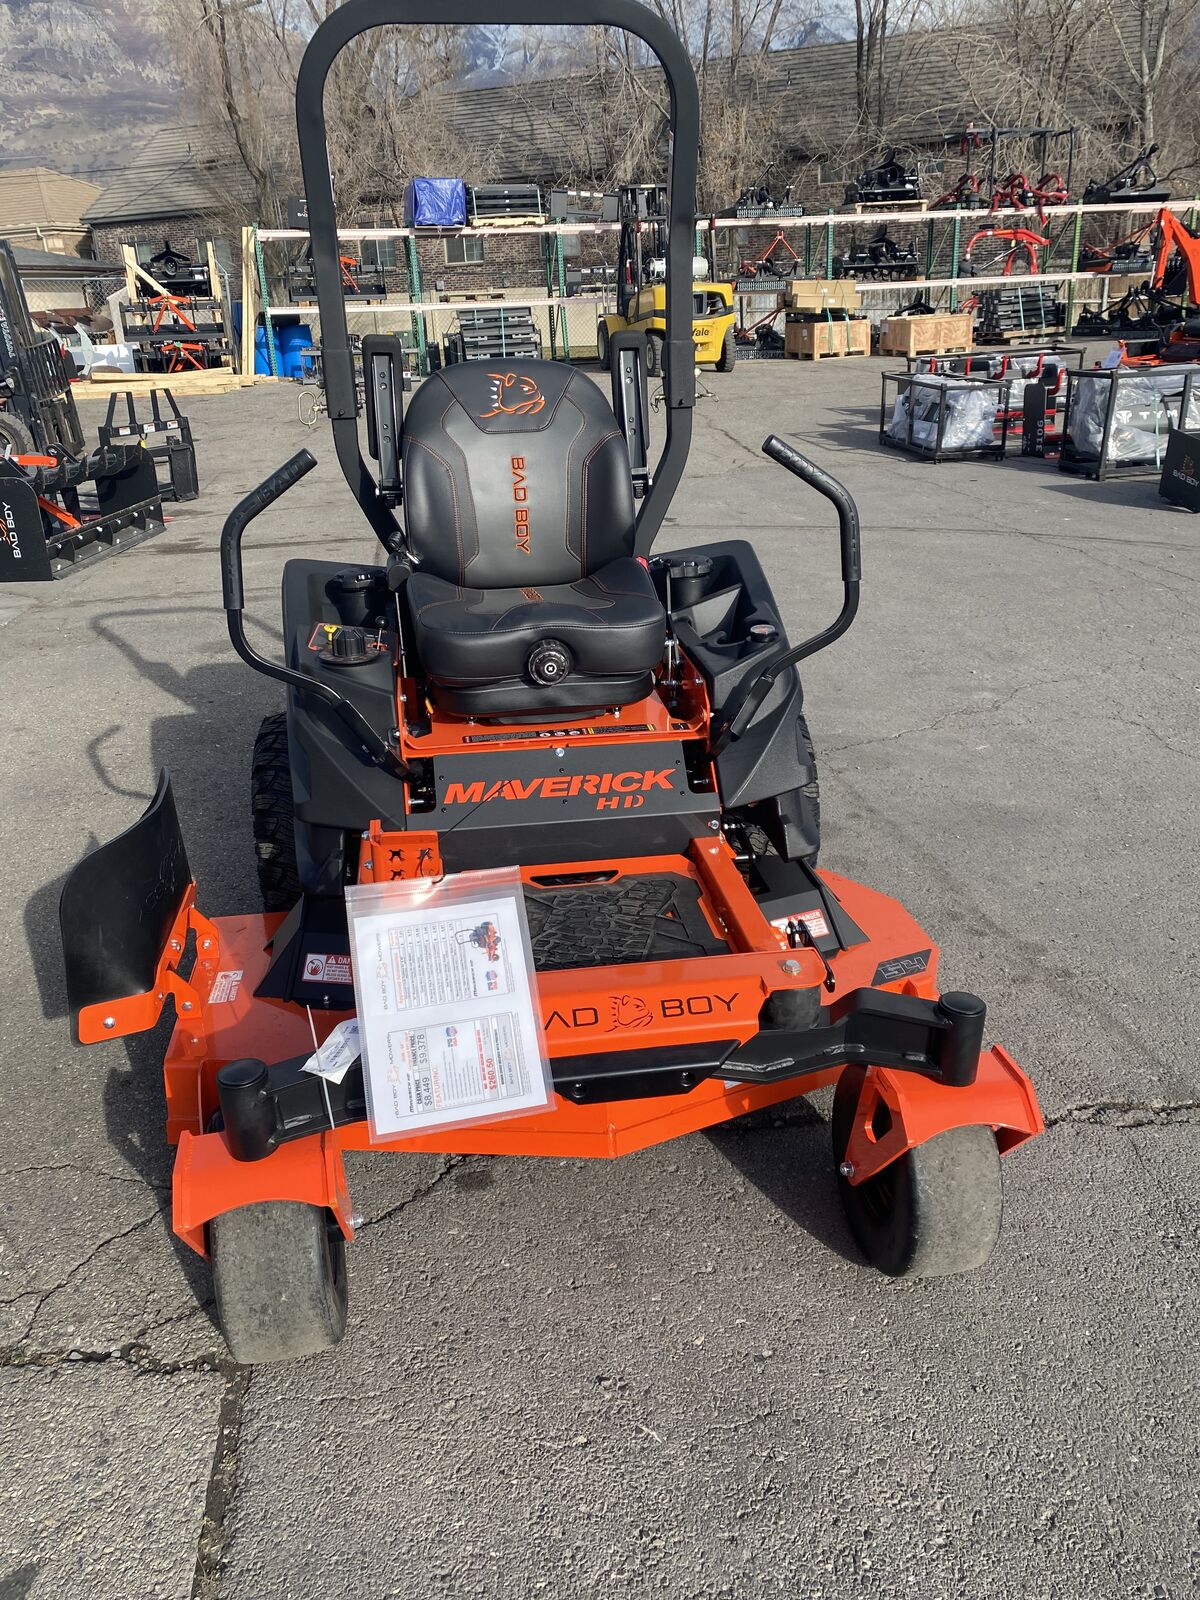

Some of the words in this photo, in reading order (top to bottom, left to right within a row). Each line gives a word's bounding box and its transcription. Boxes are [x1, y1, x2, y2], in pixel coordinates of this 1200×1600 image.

[1140, 410, 1178, 420] TYM
[1036, 420, 1044, 452] 3106
[257, 461, 306, 504] BAD
[511, 456, 528, 503] BAD
[1172, 470, 1186, 480] BAD
[2, 502, 16, 528] BOY
[10, 532, 22, 558] BAD
[514, 509, 532, 556] BOY
[444, 768, 676, 804] MAVERICK
[596, 794, 645, 810] HD
[798, 912, 821, 920] DANGER
[544, 1007, 598, 1030] AD
[661, 992, 740, 1018] BOY
[416, 1033, 427, 1064] $9,378
[485, 1057, 497, 1089] $260.50
[421, 1076, 432, 1106] $8,449
